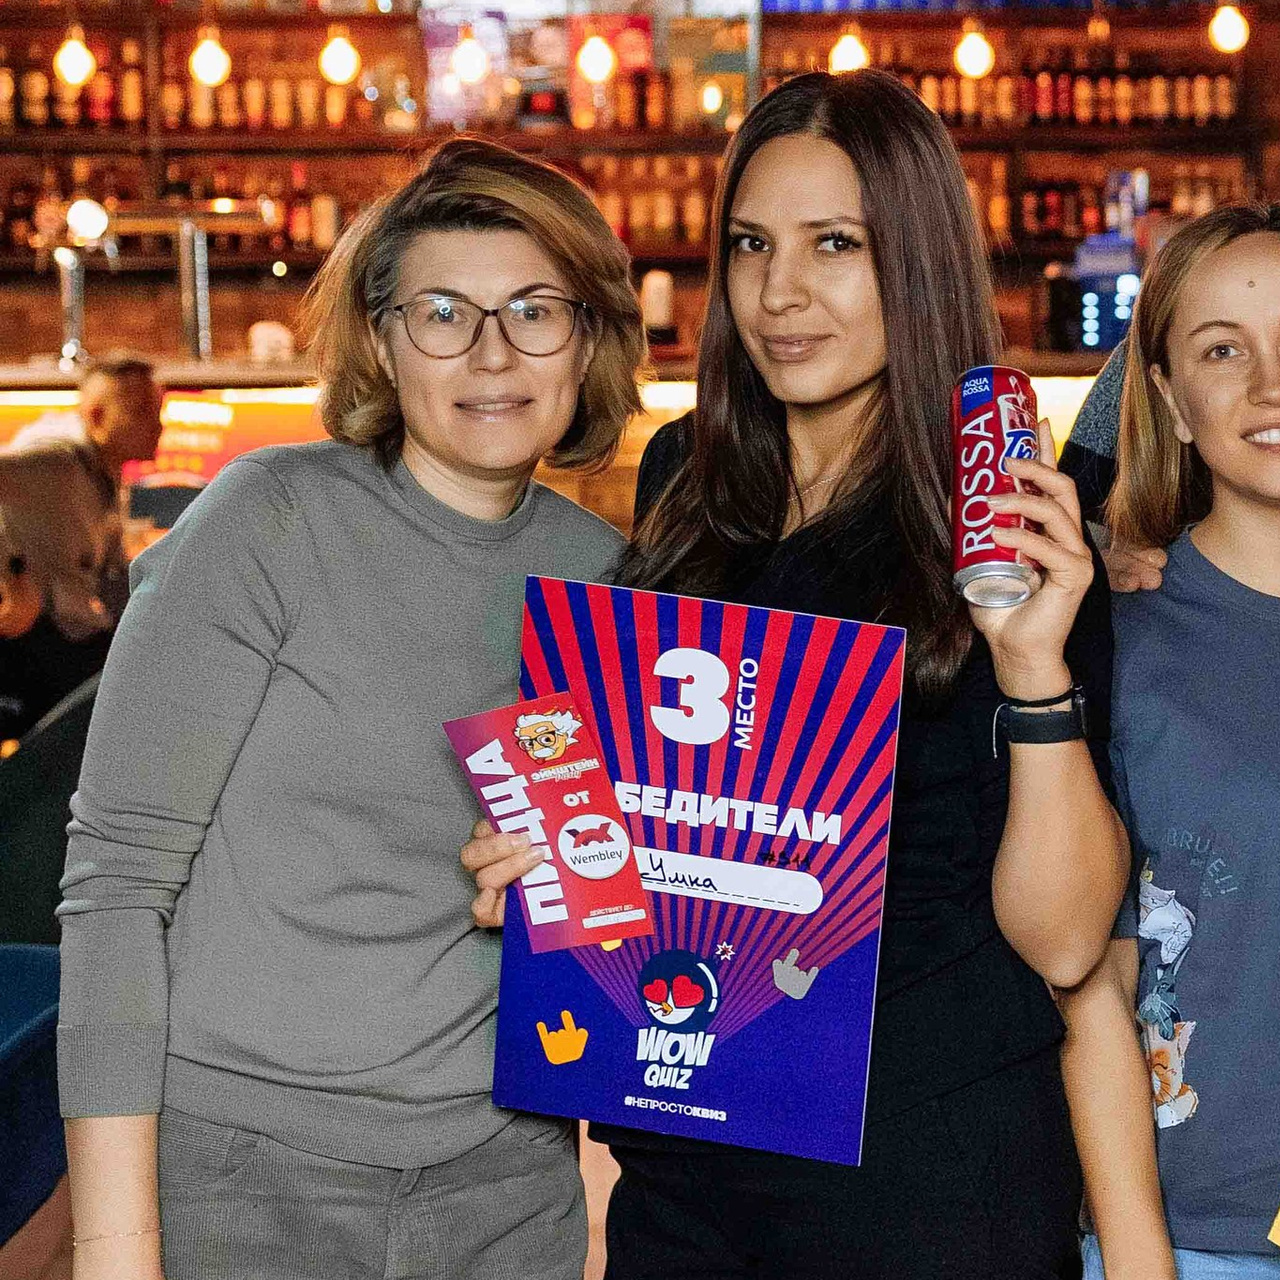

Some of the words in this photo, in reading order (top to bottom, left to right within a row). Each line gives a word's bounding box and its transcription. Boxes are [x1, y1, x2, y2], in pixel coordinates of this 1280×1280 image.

[962, 384, 990, 398] ROSSA
[964, 377, 989, 389] AQUA
[961, 411, 996, 557] ROSSA
[650, 647, 730, 745] 3
[733, 658, 759, 751] МЕСТО
[563, 790, 590, 807] ОТ
[614, 780, 842, 846] БЕДИТЕЛИ
[570, 849, 624, 867] Wembley
[636, 1026, 716, 1066] WOW
[643, 1063, 693, 1090] QUIZ
[624, 1095, 728, 1122] #НЕПРОСТОКВИЗ
